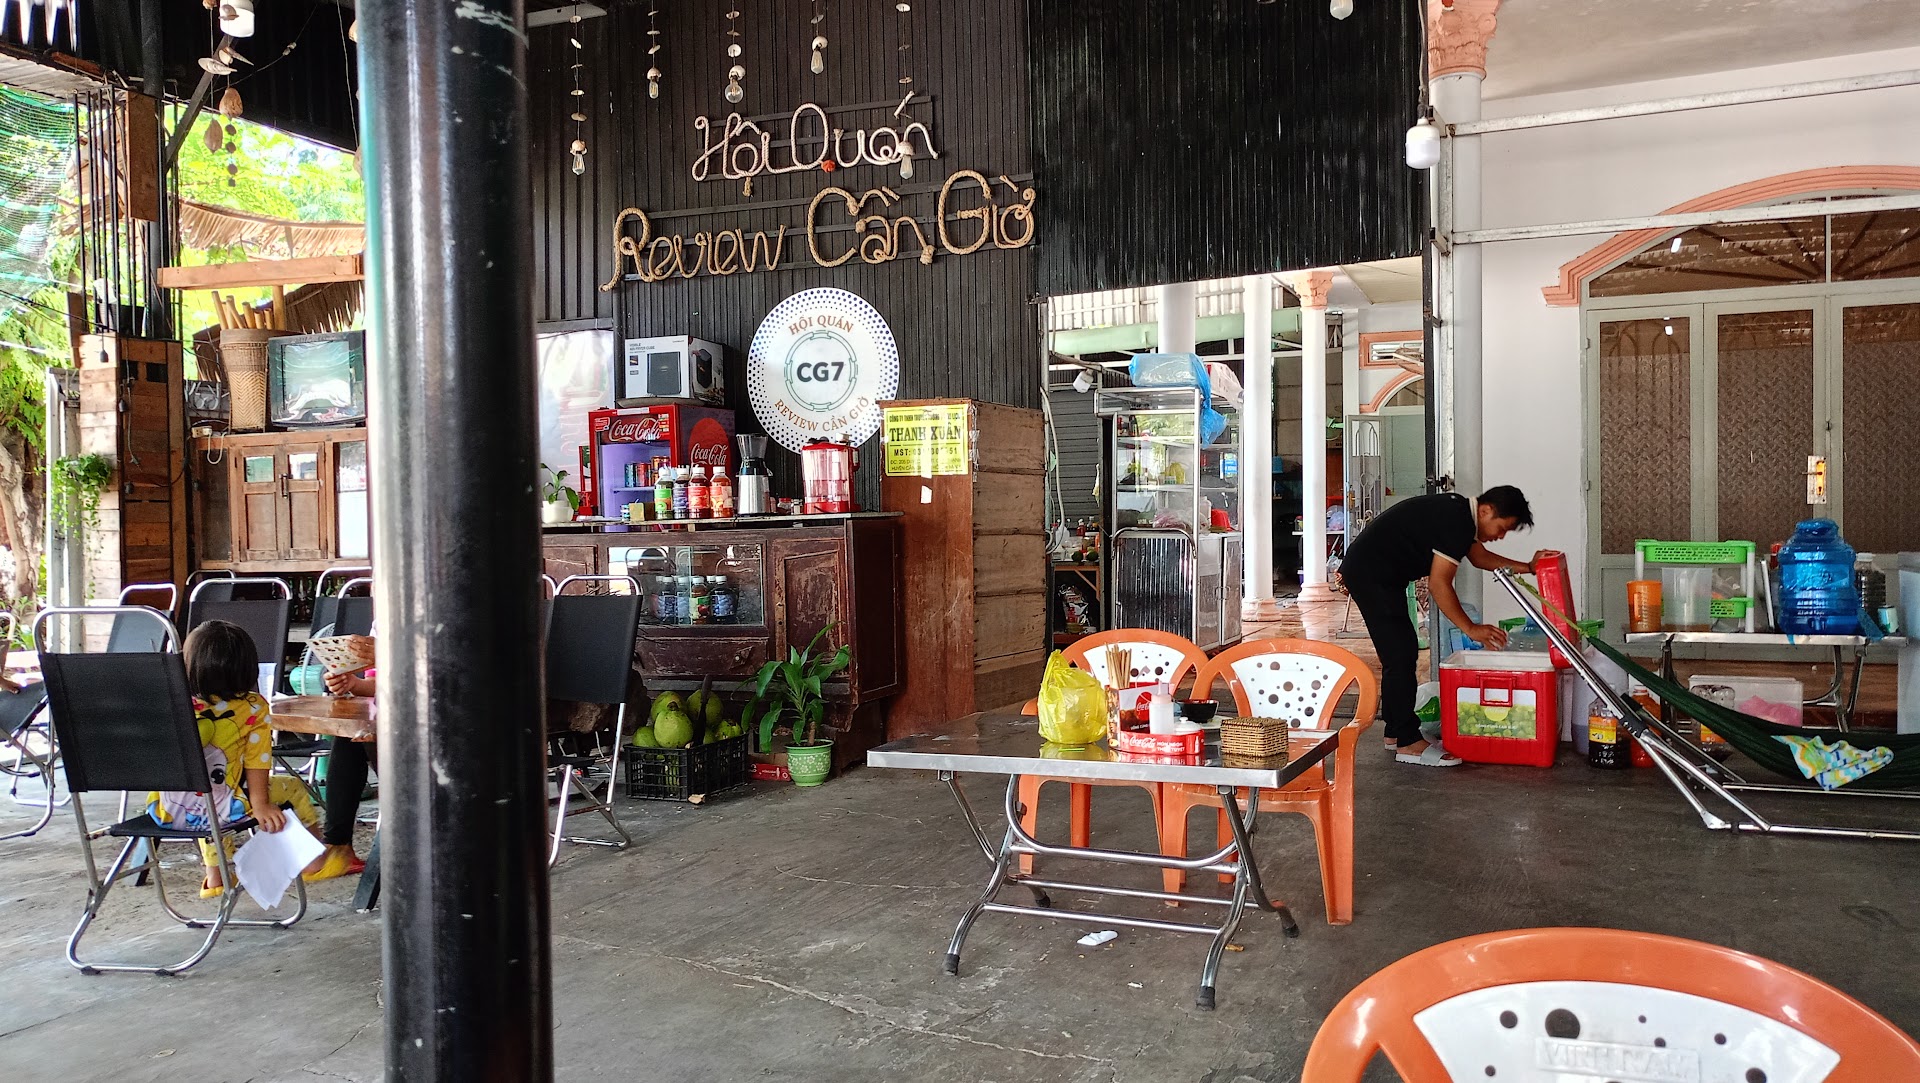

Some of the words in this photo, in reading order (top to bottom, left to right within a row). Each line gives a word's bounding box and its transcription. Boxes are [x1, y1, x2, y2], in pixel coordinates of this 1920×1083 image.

[598, 207, 786, 292] Review
[807, 185, 936, 268] Cần
[937, 169, 1037, 255] Giờ
[788, 315, 813, 335] HỘI
[817, 315, 854, 333] QUÁN
[796, 361, 844, 382] CG7
[774, 399, 819, 431] REVIEW
[822, 415, 848, 432] CẦN
[849, 396, 870, 420] GIỜ
[889, 426, 926, 442] THANH
[930, 422, 961, 440] XUÂN
[894, 448, 911, 457] MST:
